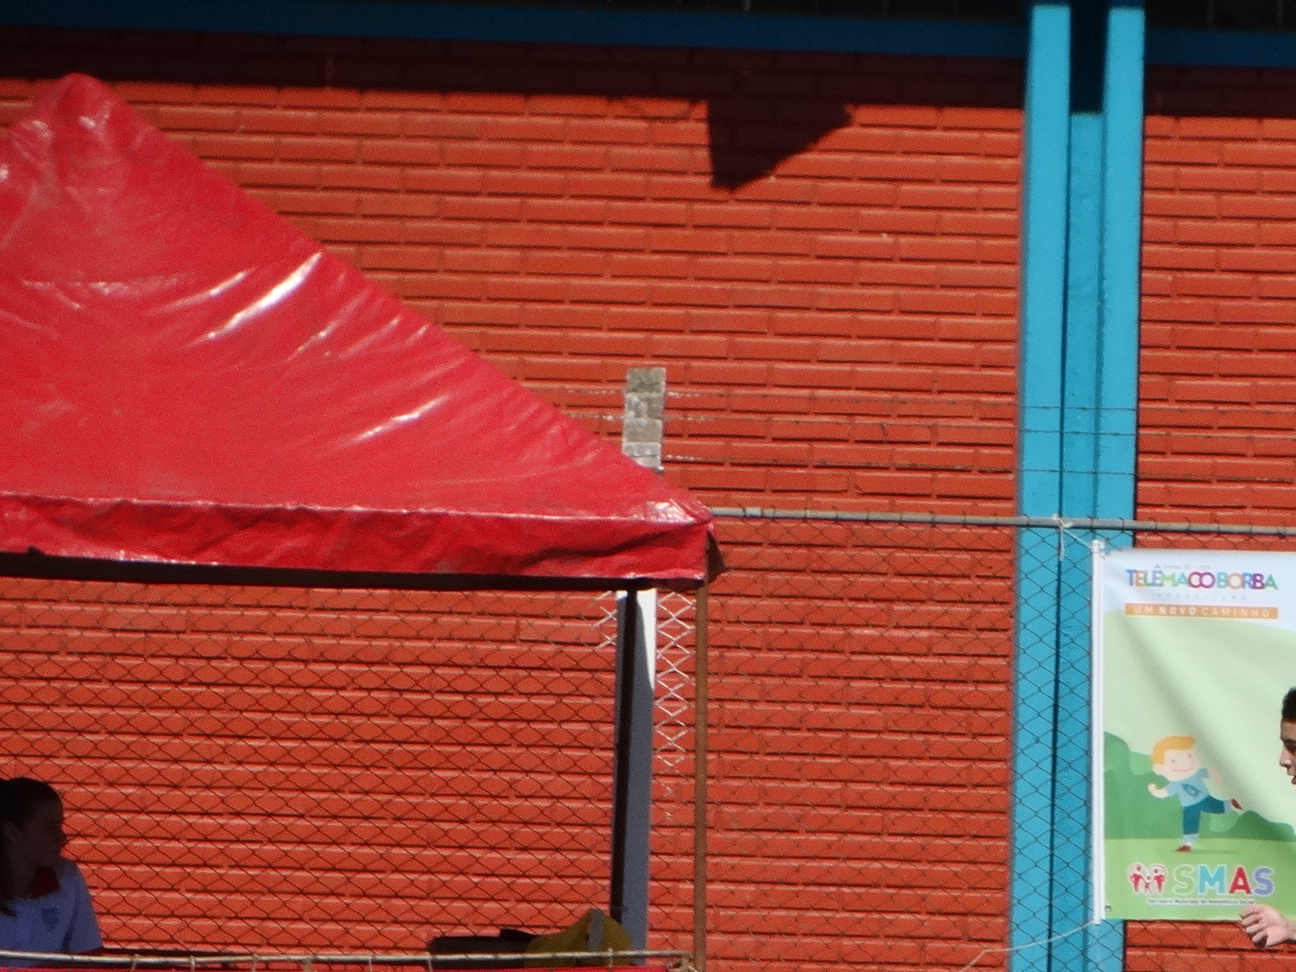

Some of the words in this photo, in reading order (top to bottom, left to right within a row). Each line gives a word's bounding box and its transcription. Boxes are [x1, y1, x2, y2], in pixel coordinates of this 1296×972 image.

[1217, 571, 1280, 591] BORBA
[1158, 606, 1198, 616] NOVO
[1200, 607, 1271, 618] CAMINHO
[1172, 864, 1275, 897] SMAS
